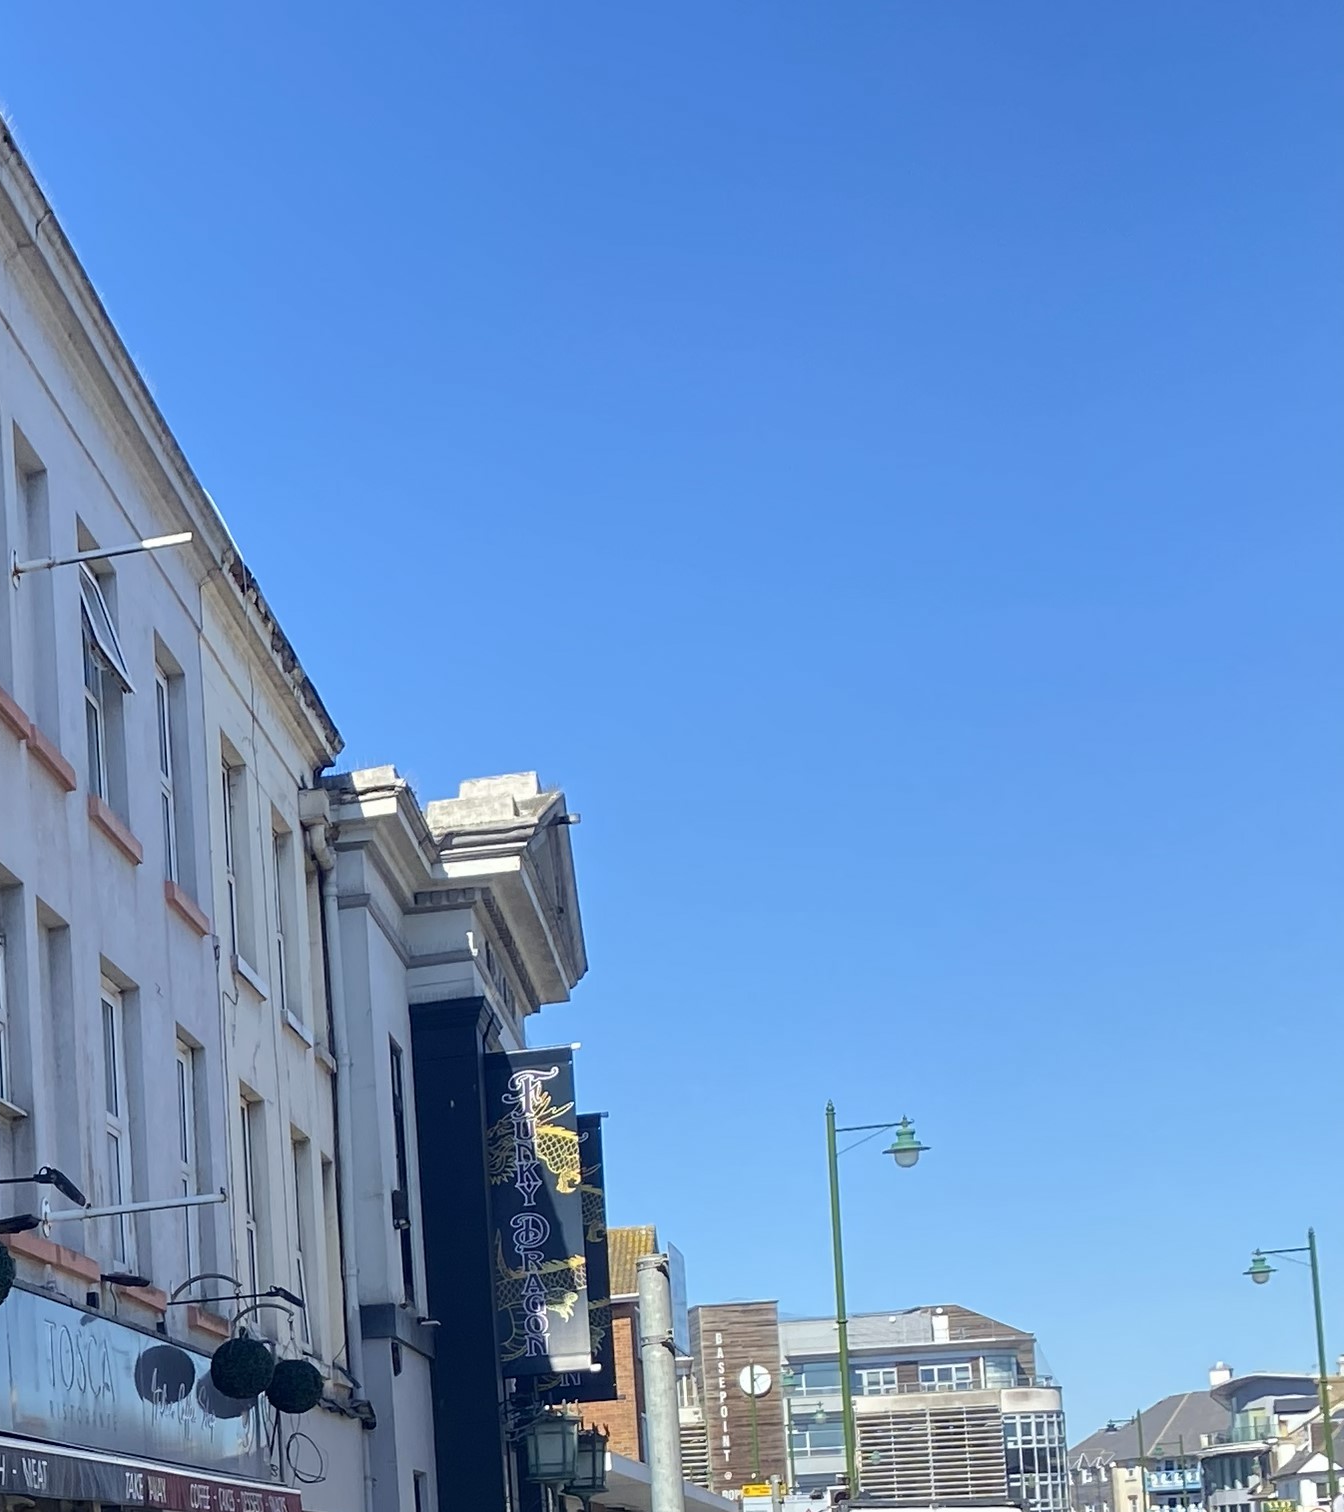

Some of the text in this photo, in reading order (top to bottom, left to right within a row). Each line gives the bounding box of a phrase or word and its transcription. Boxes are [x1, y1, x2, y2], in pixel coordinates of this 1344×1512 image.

[43, 1318, 116, 1402] TOSCA
[715, 1332, 731, 1463] BASEPOINT
[21, 1457, 48, 1491] MEAT
[125, 1472, 144, 1500] TAKE
